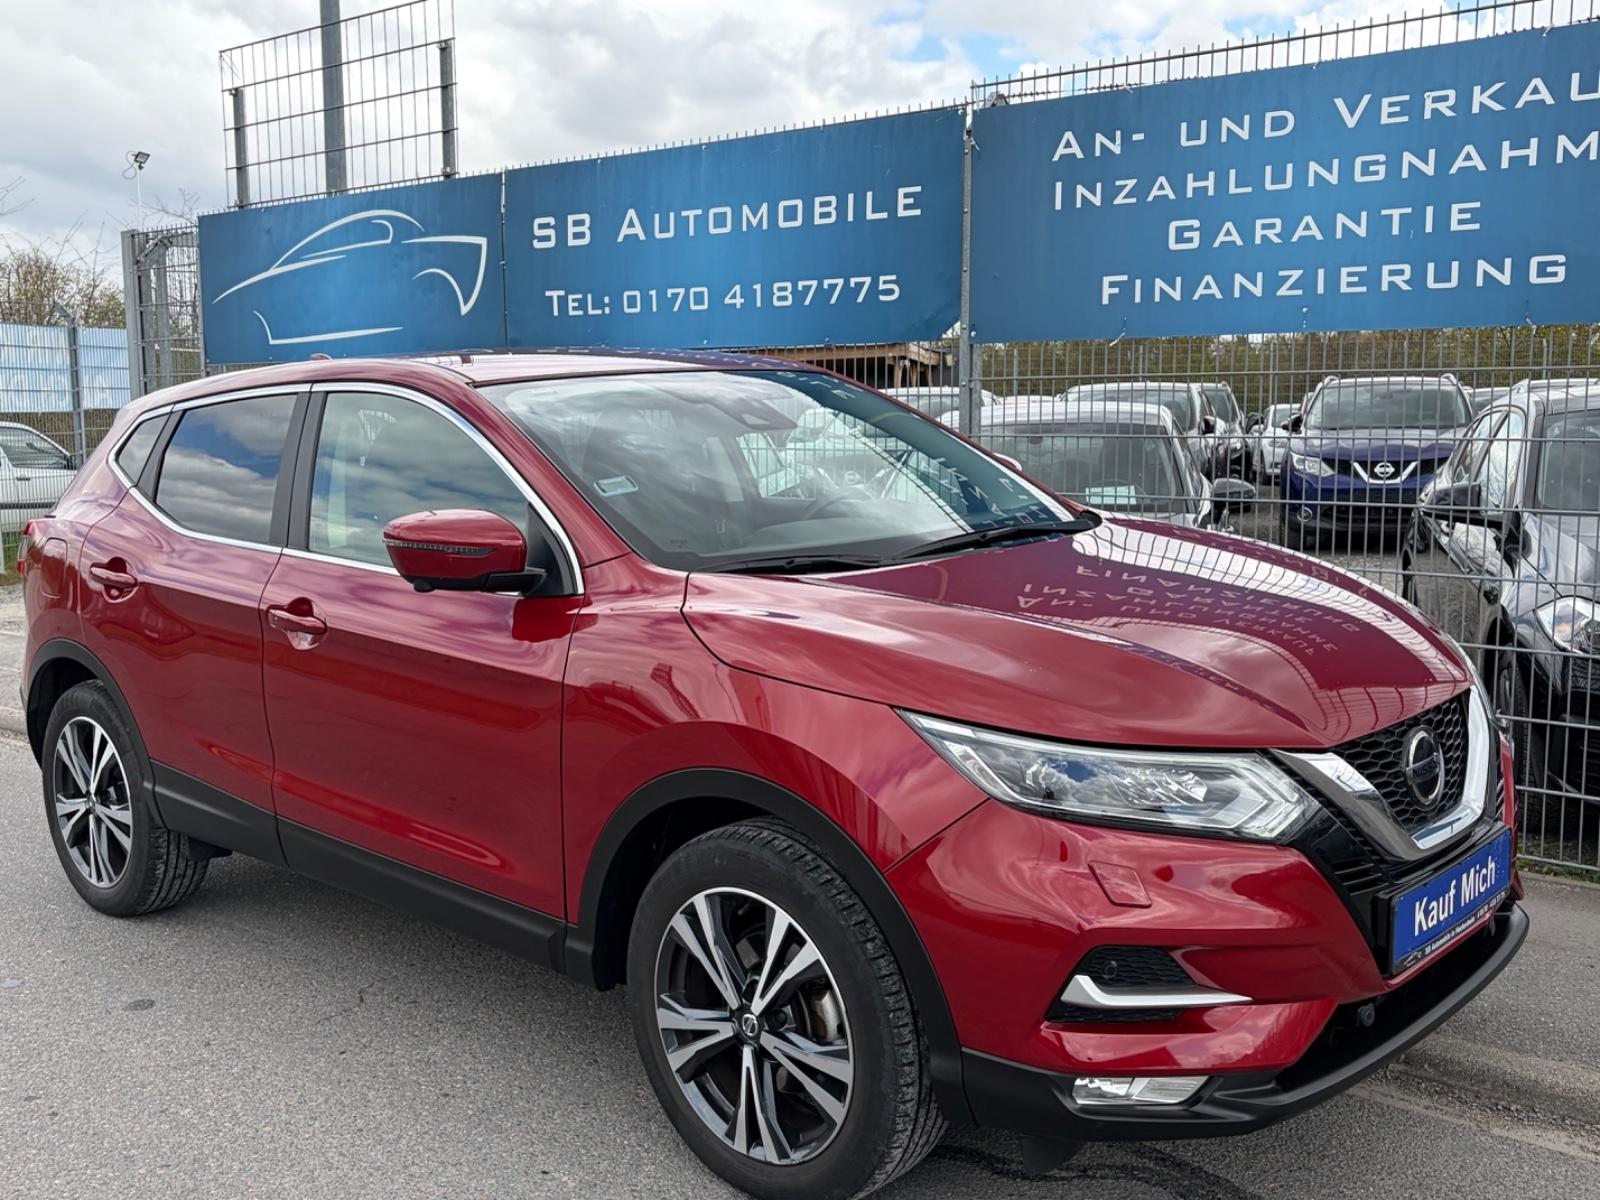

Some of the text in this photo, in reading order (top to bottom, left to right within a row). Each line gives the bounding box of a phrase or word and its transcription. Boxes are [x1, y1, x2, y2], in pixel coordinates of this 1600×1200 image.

[1052, 129, 1145, 162] AN-
[1180, 110, 1295, 147] UND
[532, 185, 922, 249] SB AUTOMOBILE
[1168, 201, 1481, 251] GARANTIE
[545, 274, 901, 317] TEL: 0170 4187775
[1102, 254, 1567, 305] FINANZIERUNG
[1414, 879, 1457, 937] Kauf
[1460, 855, 1496, 907] Mich
